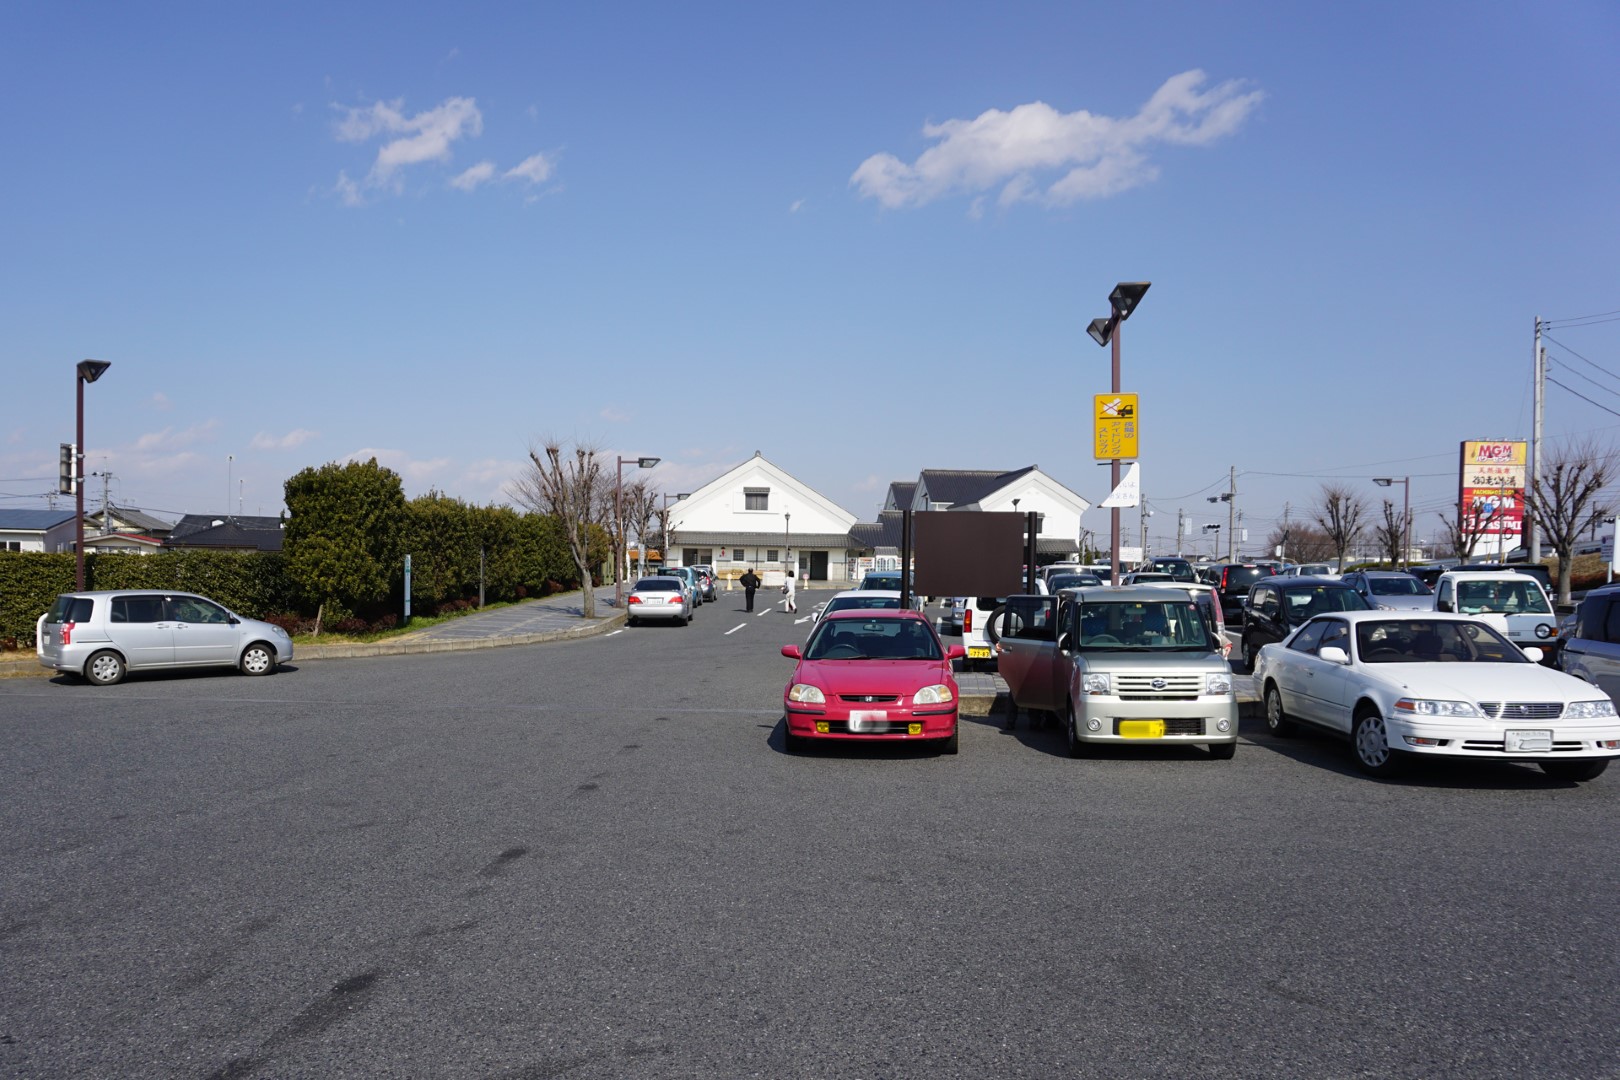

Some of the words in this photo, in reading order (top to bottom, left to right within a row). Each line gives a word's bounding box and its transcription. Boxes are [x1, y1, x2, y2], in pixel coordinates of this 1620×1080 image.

[1099, 427, 1109, 454] ストップ
[1111, 421, 1121, 455] アイドリング
[1478, 444, 1512, 457] MGM
[1472, 496, 1515, 508] MGM
